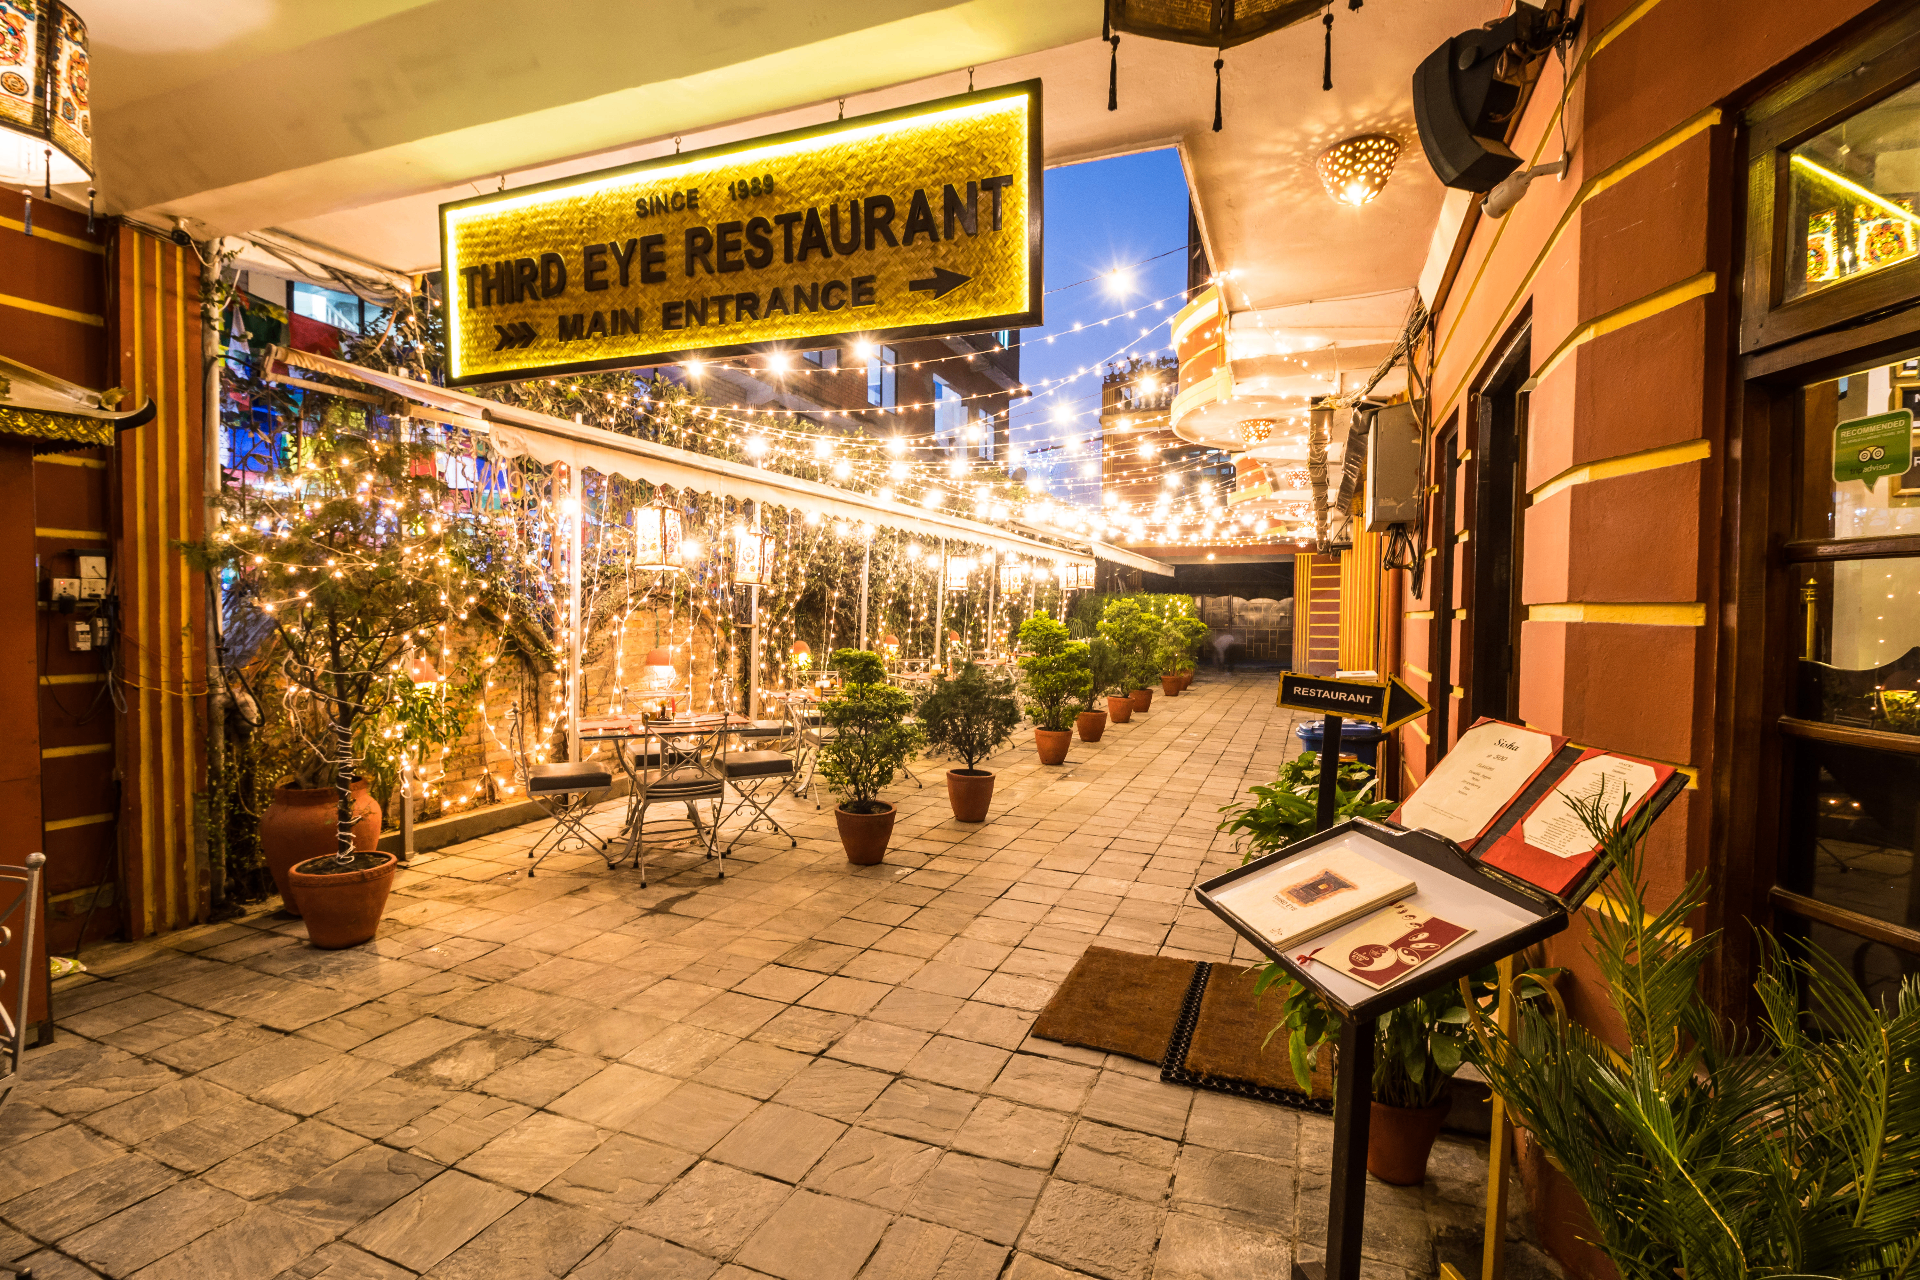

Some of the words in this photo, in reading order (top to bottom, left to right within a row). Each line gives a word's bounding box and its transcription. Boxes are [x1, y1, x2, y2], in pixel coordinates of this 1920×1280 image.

[635, 187, 699, 218] SINCE
[727, 173, 775, 201] 1989
[460, 251, 567, 309] THIRD
[583, 233, 667, 292] EYE
[685, 173, 1014, 277] RESTAURANT
[558, 307, 640, 342] MAIN
[662, 275, 877, 331] ENTRANCE
[1841, 420, 1905, 438] RECOMMENDED
[1850, 463, 1891, 475] tripadvisor
[1293, 686, 1373, 704] RESTAURANT
[1493, 738, 1520, 751] Sisha
